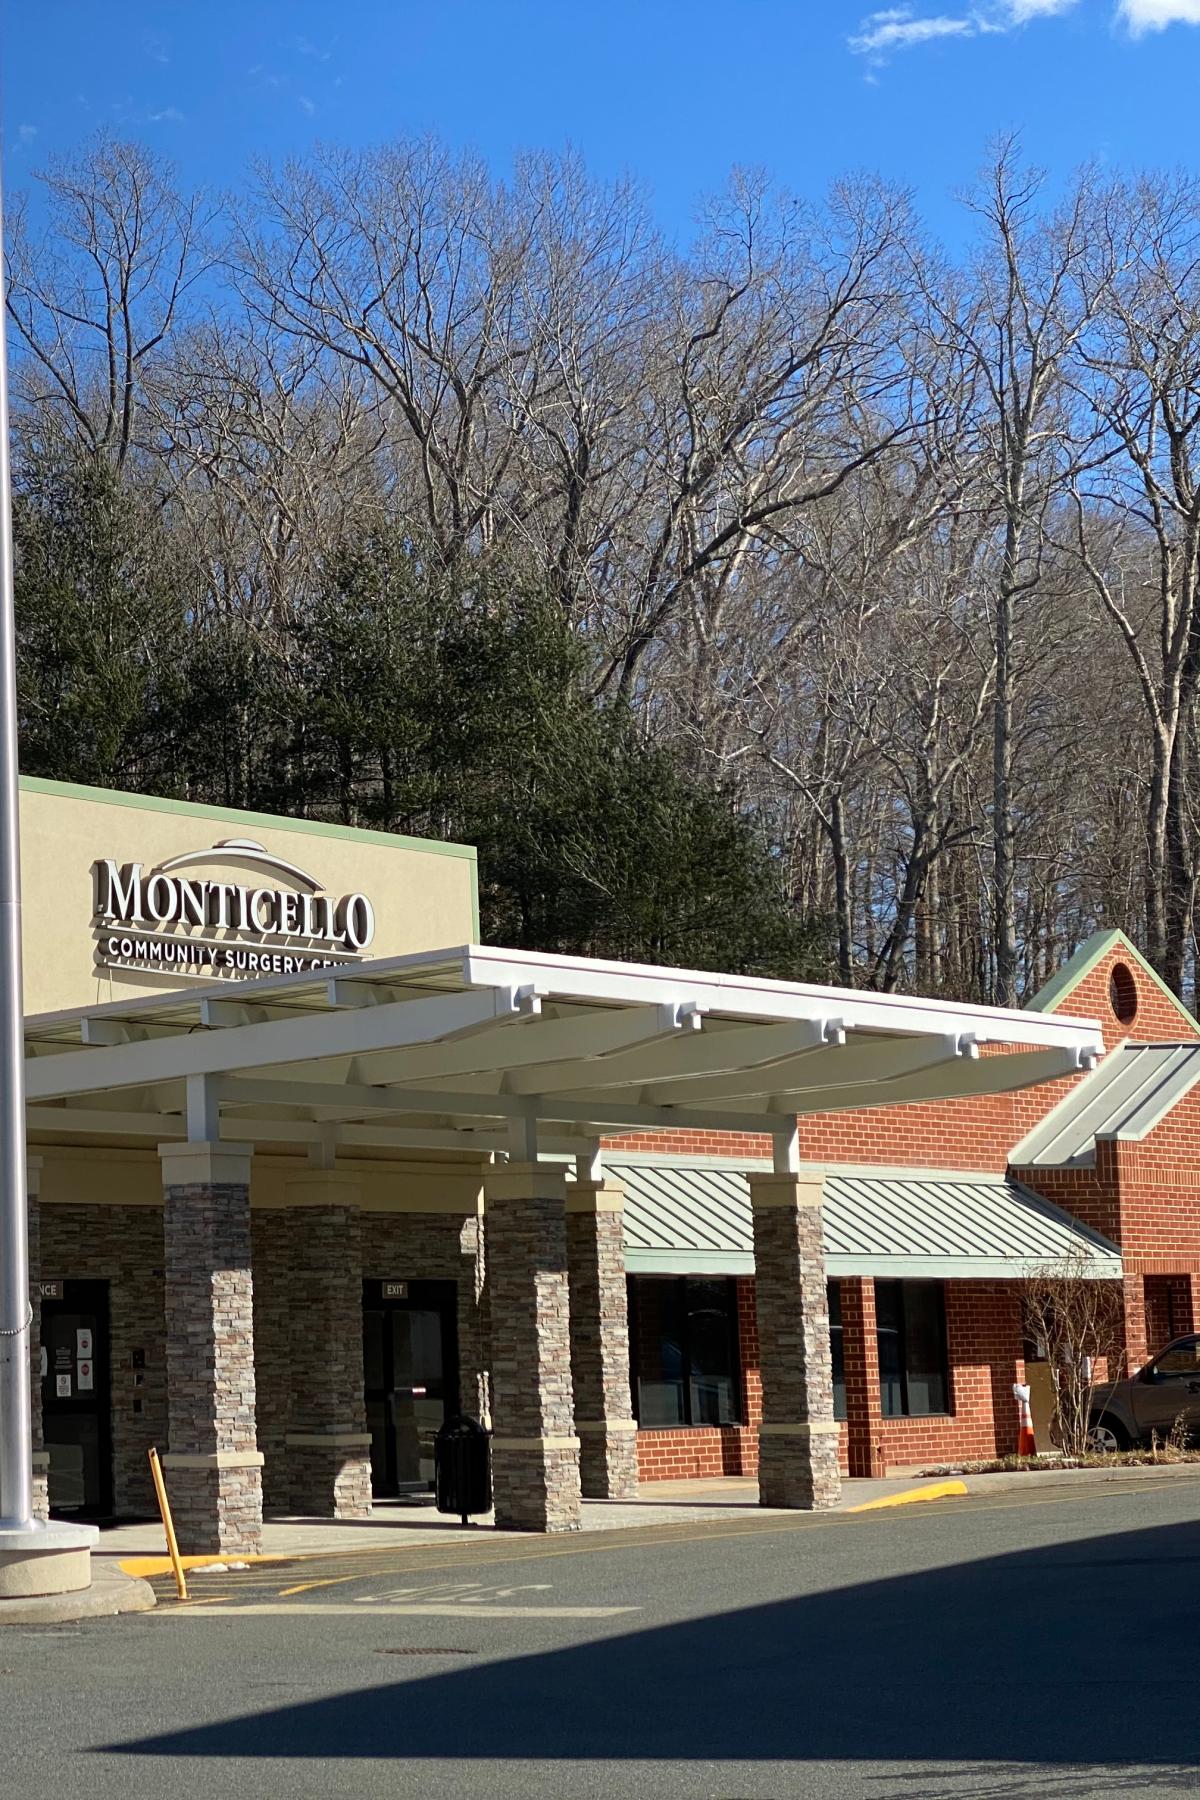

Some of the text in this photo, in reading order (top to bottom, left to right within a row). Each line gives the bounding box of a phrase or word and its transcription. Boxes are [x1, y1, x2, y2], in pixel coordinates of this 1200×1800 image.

[103, 858, 375, 949] MONTICELLO
[108, 936, 218, 966] COMMUNITY
[225, 949, 304, 974] SURGERY
[387, 1285, 404, 1295] EXIT
